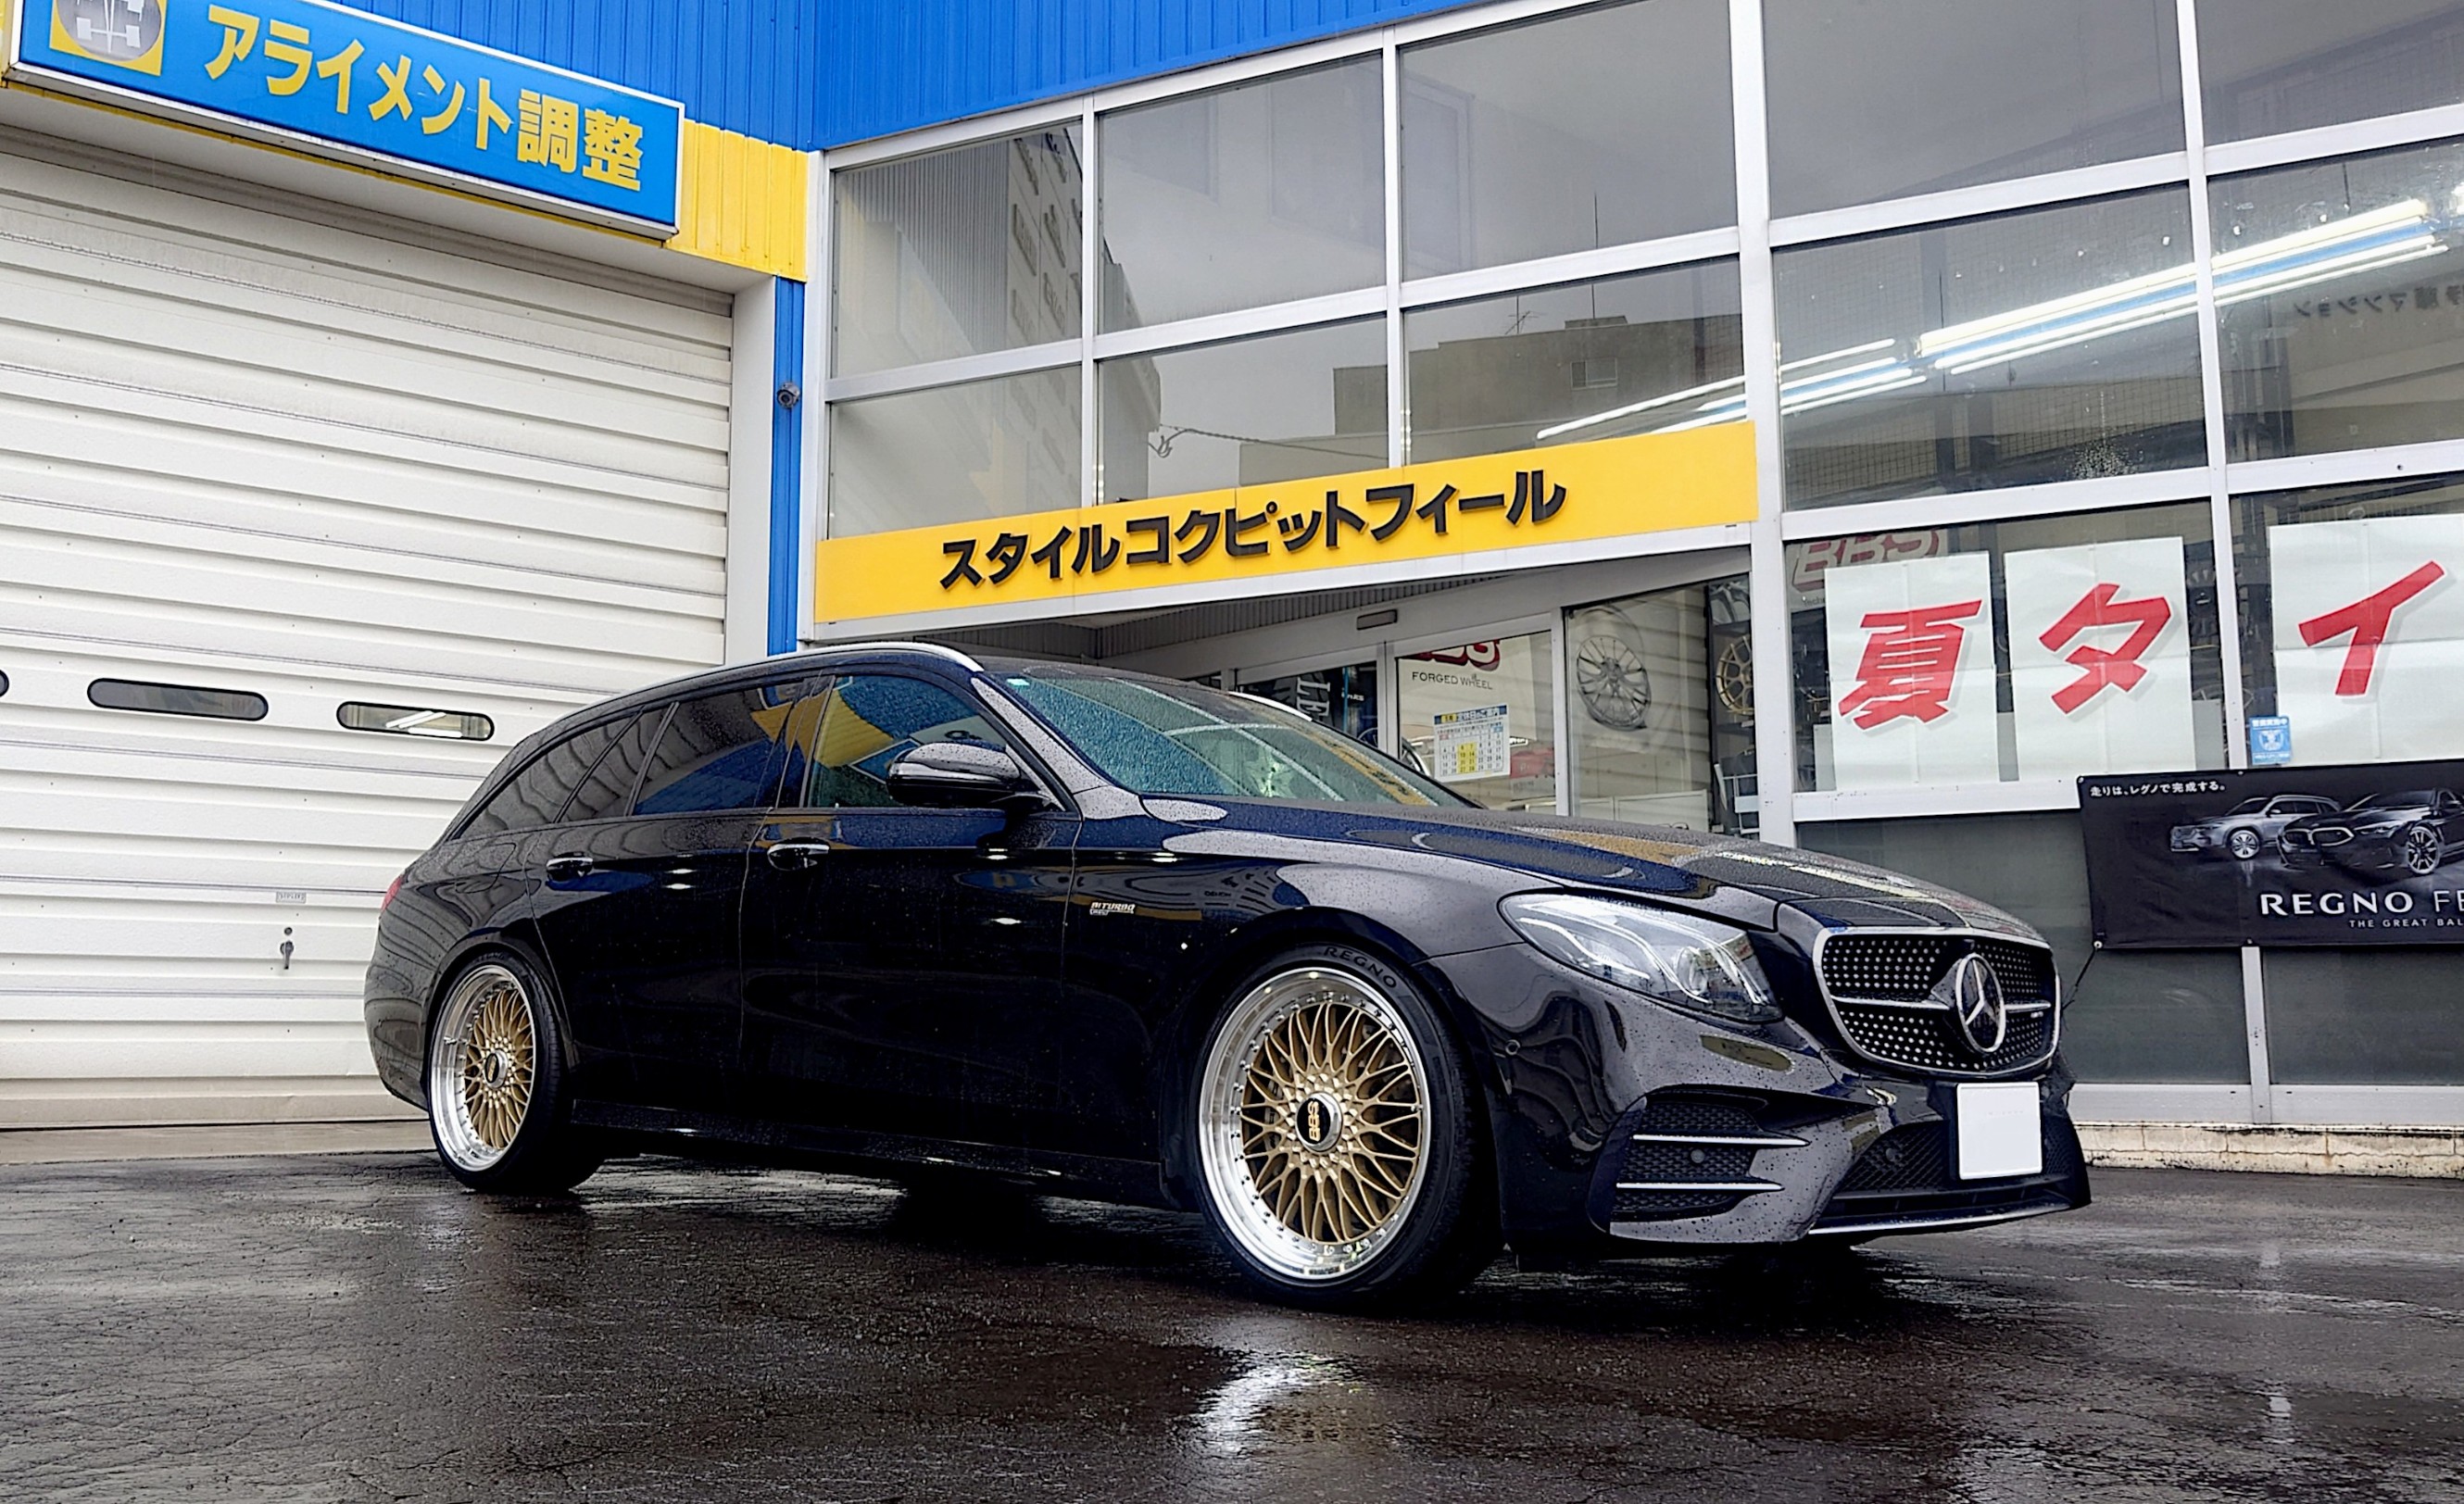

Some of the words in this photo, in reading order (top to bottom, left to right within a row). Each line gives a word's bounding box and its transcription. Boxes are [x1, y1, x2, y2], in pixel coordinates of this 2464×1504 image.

[205, 5, 644, 192] アライメント調整
[939, 470, 1566, 589] スタイルコクピットフィール
[1412, 671, 1458, 685] FORGED
[1460, 676, 1493, 690] WHEEL
[2090, 781, 2225, 797] 走りは、レグノで完成する。
[2260, 892, 2413, 916] REGNO
[2349, 920, 2375, 928] THE
[2382, 919, 2428, 927] GREAT
[2437, 917, 2464, 926] BAL
[1324, 946, 1397, 988] REGNO
[1308, 1101, 1321, 1142] BBS
